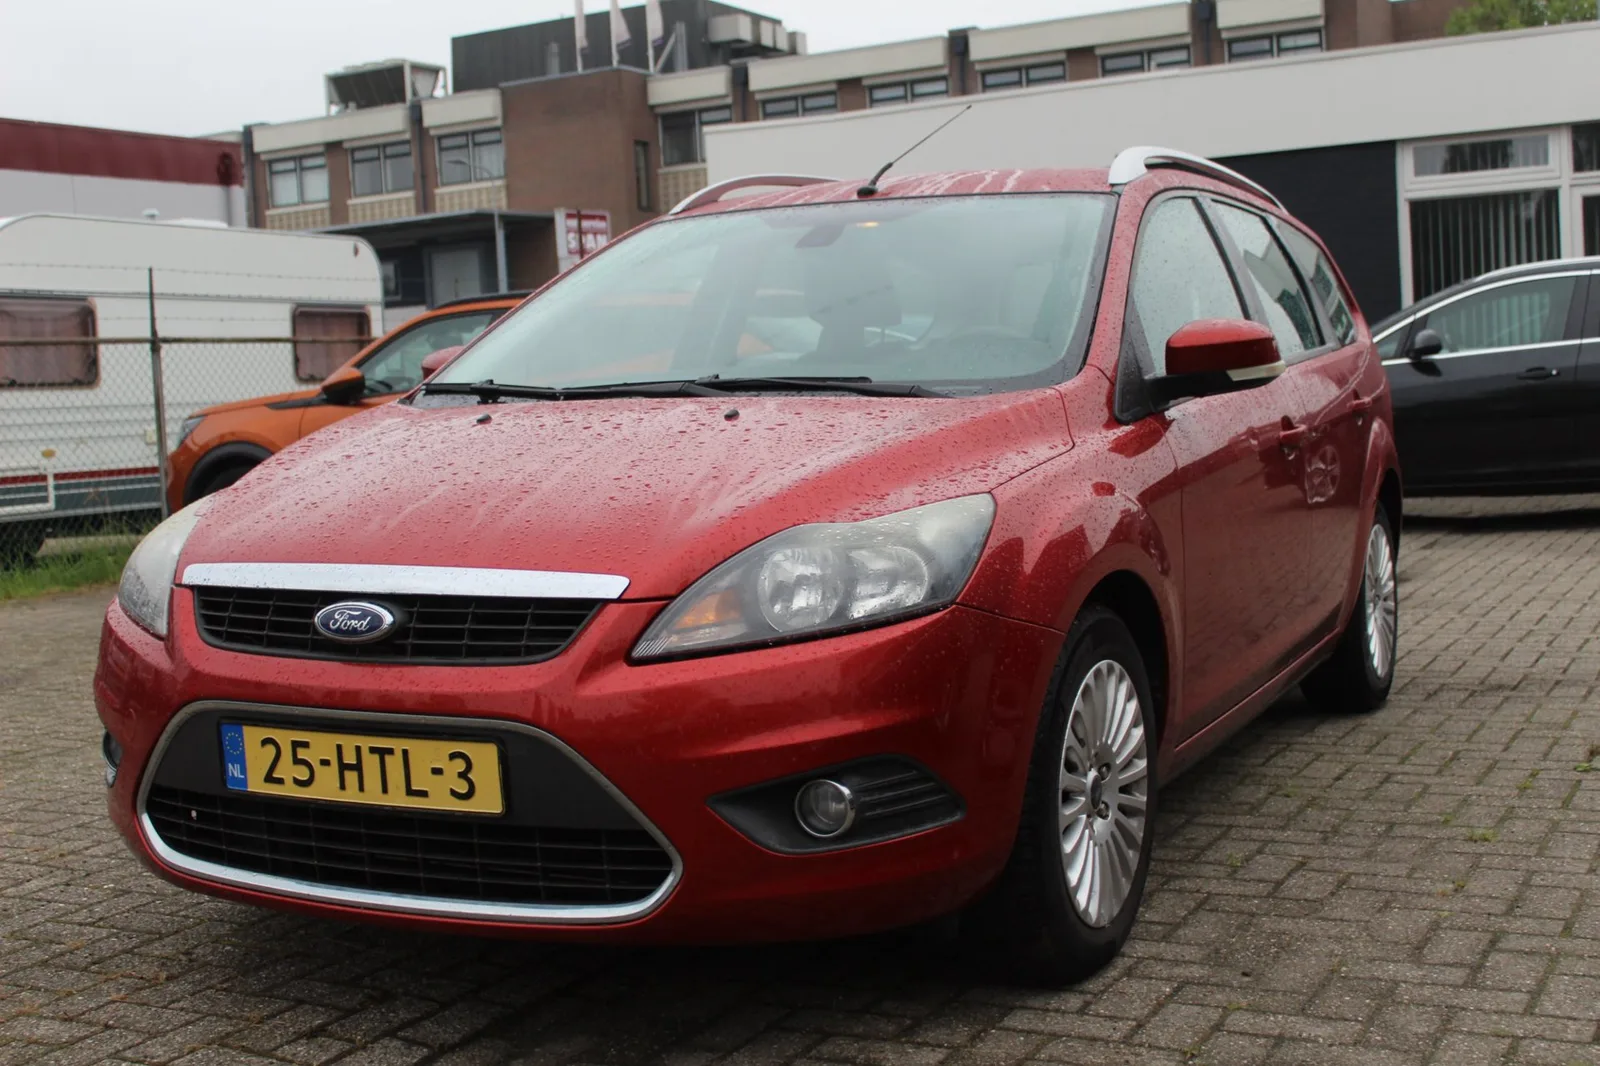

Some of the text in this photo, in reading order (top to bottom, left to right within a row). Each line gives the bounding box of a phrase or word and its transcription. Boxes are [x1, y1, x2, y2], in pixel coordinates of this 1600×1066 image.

[329, 609, 373, 632] Ford
[228, 763, 245, 779] NL
[260, 736, 477, 801] 25-HTL-3
